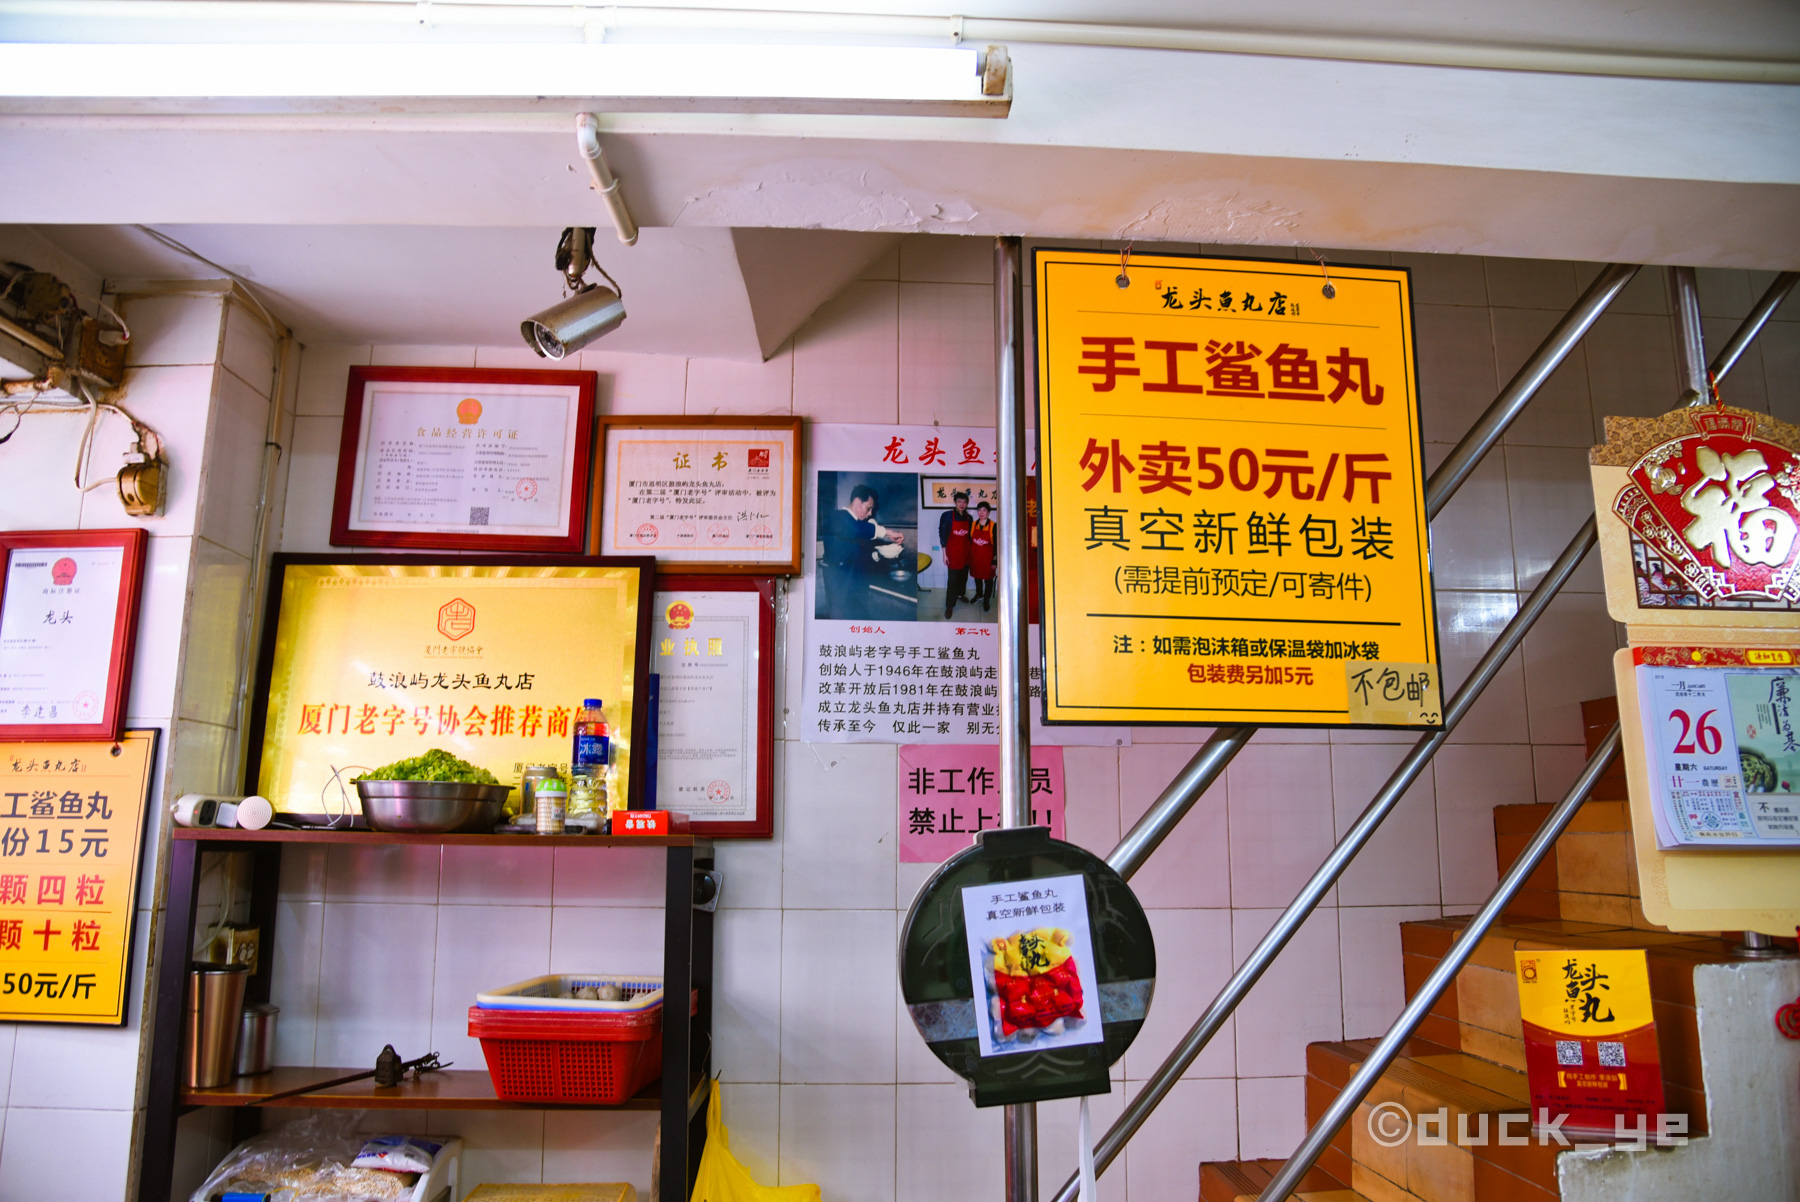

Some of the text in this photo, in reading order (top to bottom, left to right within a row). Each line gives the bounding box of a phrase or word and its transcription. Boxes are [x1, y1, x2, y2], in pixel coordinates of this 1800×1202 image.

[1078, 335, 1385, 406] 手工鲨鱼丸
[417, 427, 518, 440] 食品经营许可证
[673, 451, 729, 471] 证书
[1078, 437, 1392, 504] 外卖50元/斤
[1680, 446, 1798, 569] 福
[1084, 505, 1395, 560] 真空新鲜包装
[1114, 565, 1372, 602] (需提前预定/可寄件)
[43, 610, 73, 625] 龙头
[850, 626, 885, 634] 创始人
[955, 627, 991, 636] 第二代
[819, 644, 980, 661] 鼓浪屿老字号手工鲨鱼丸
[367, 671, 535, 691] 鼓浪屿龙头鱼丸店
[1187, 663, 1314, 686] 包装费另加5元
[1351, 667, 1429, 707] 不包邮
[818, 701, 1000, 716] 成立龙头鱼丸店并持有营业
[818, 719, 876, 733] 传承至今
[893, 720, 951, 734] 仅此一家
[1669, 709, 1722, 755] 26
[1675, 763, 1698, 771] 星期六
[908, 767, 1053, 795] 非工作员
[0, 791, 113, 820] 工鲨鱼丸
[1, 827, 109, 857] 份15元
[0, 873, 105, 906] 颗四粒
[990, 888, 1058, 905] 手工鲨鱼丸
[986, 902, 1066, 920] 真空新鲜包装
[0, 918, 101, 952] 颗十粒
[3, 973, 97, 999] 50元/斤
